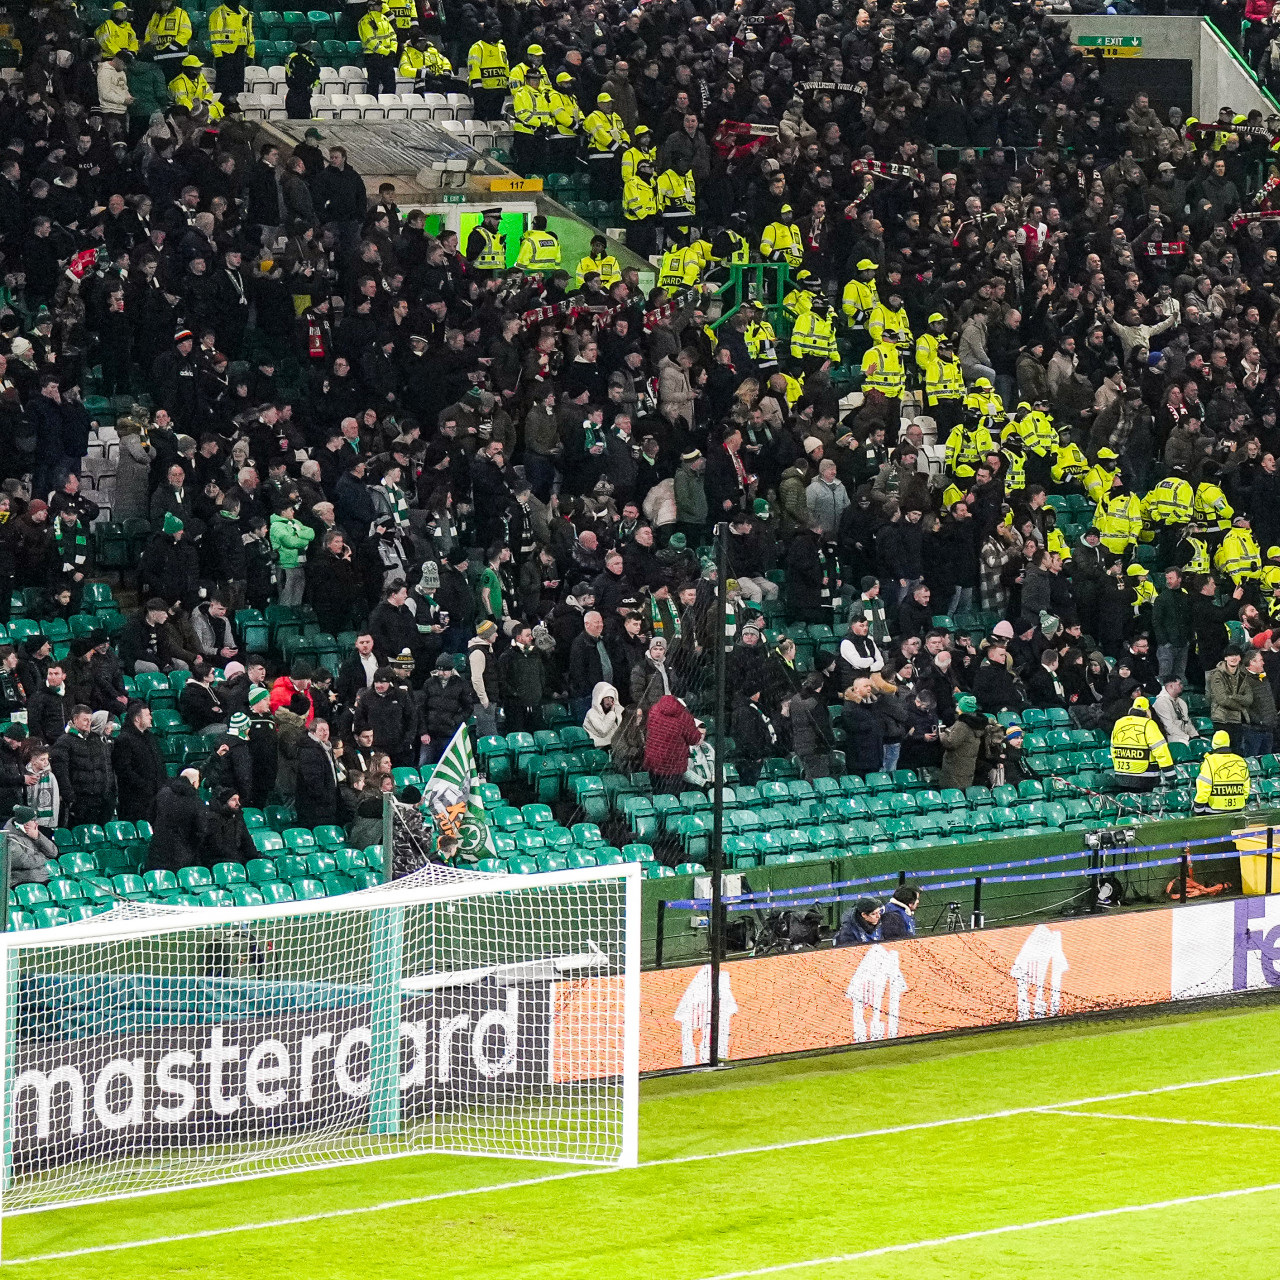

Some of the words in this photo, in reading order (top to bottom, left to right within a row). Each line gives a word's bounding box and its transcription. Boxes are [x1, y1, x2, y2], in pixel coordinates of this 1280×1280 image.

[1105, 37, 1124, 46] EXIT
[510, 182, 525, 190] 117
[11, 986, 518, 1139] mastercard
